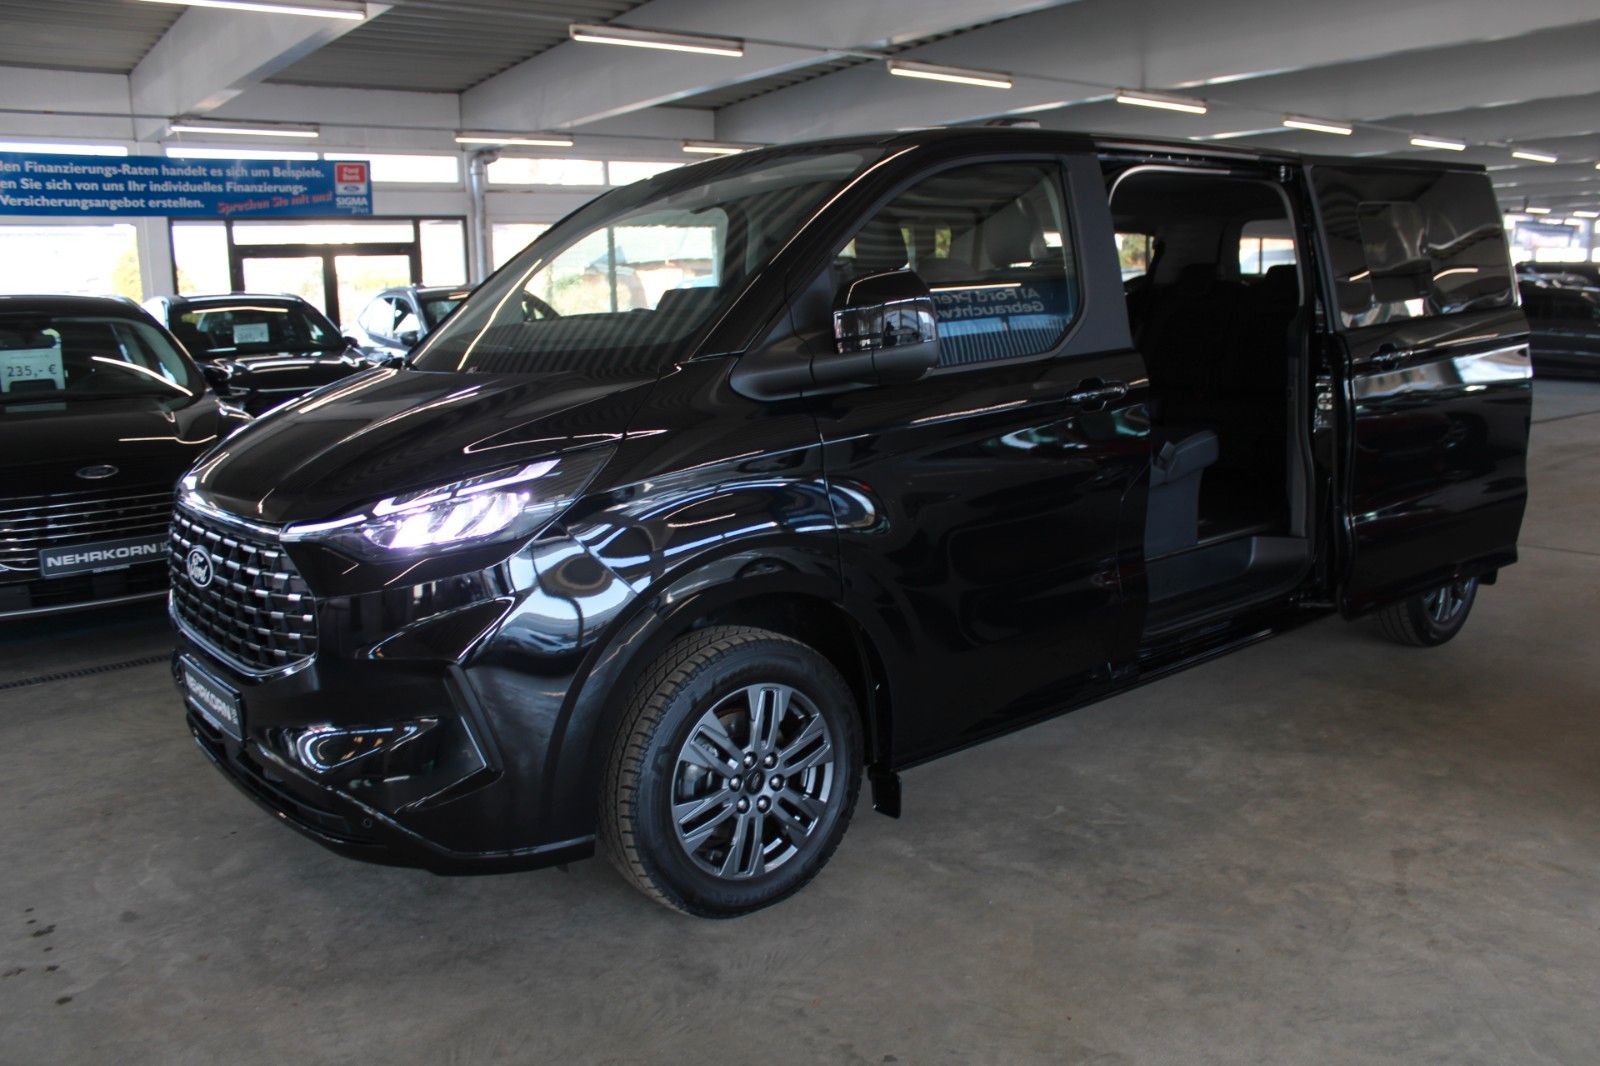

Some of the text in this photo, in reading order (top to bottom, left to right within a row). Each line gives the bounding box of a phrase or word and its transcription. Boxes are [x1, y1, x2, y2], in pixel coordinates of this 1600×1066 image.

[24, 161, 159, 178] Finanzierungs-Raten
[161, 165, 208, 177] handelt
[210, 168, 223, 177] es
[226, 166, 248, 178] sich
[251, 169, 270, 178] um
[272, 167, 324, 180] Beispiele.
[20, 178, 42, 190] Sie
[45, 179, 72, 191] sich
[74, 182, 99, 191] von
[102, 182, 125, 192] uns
[149, 181, 223, 193] individuelles
[225, 182, 307, 195] Finanzierungs-
[0, 194, 205, 211] Versicherungsangebot erstellen.
[46, 543, 157, 568] NEHRKORN
